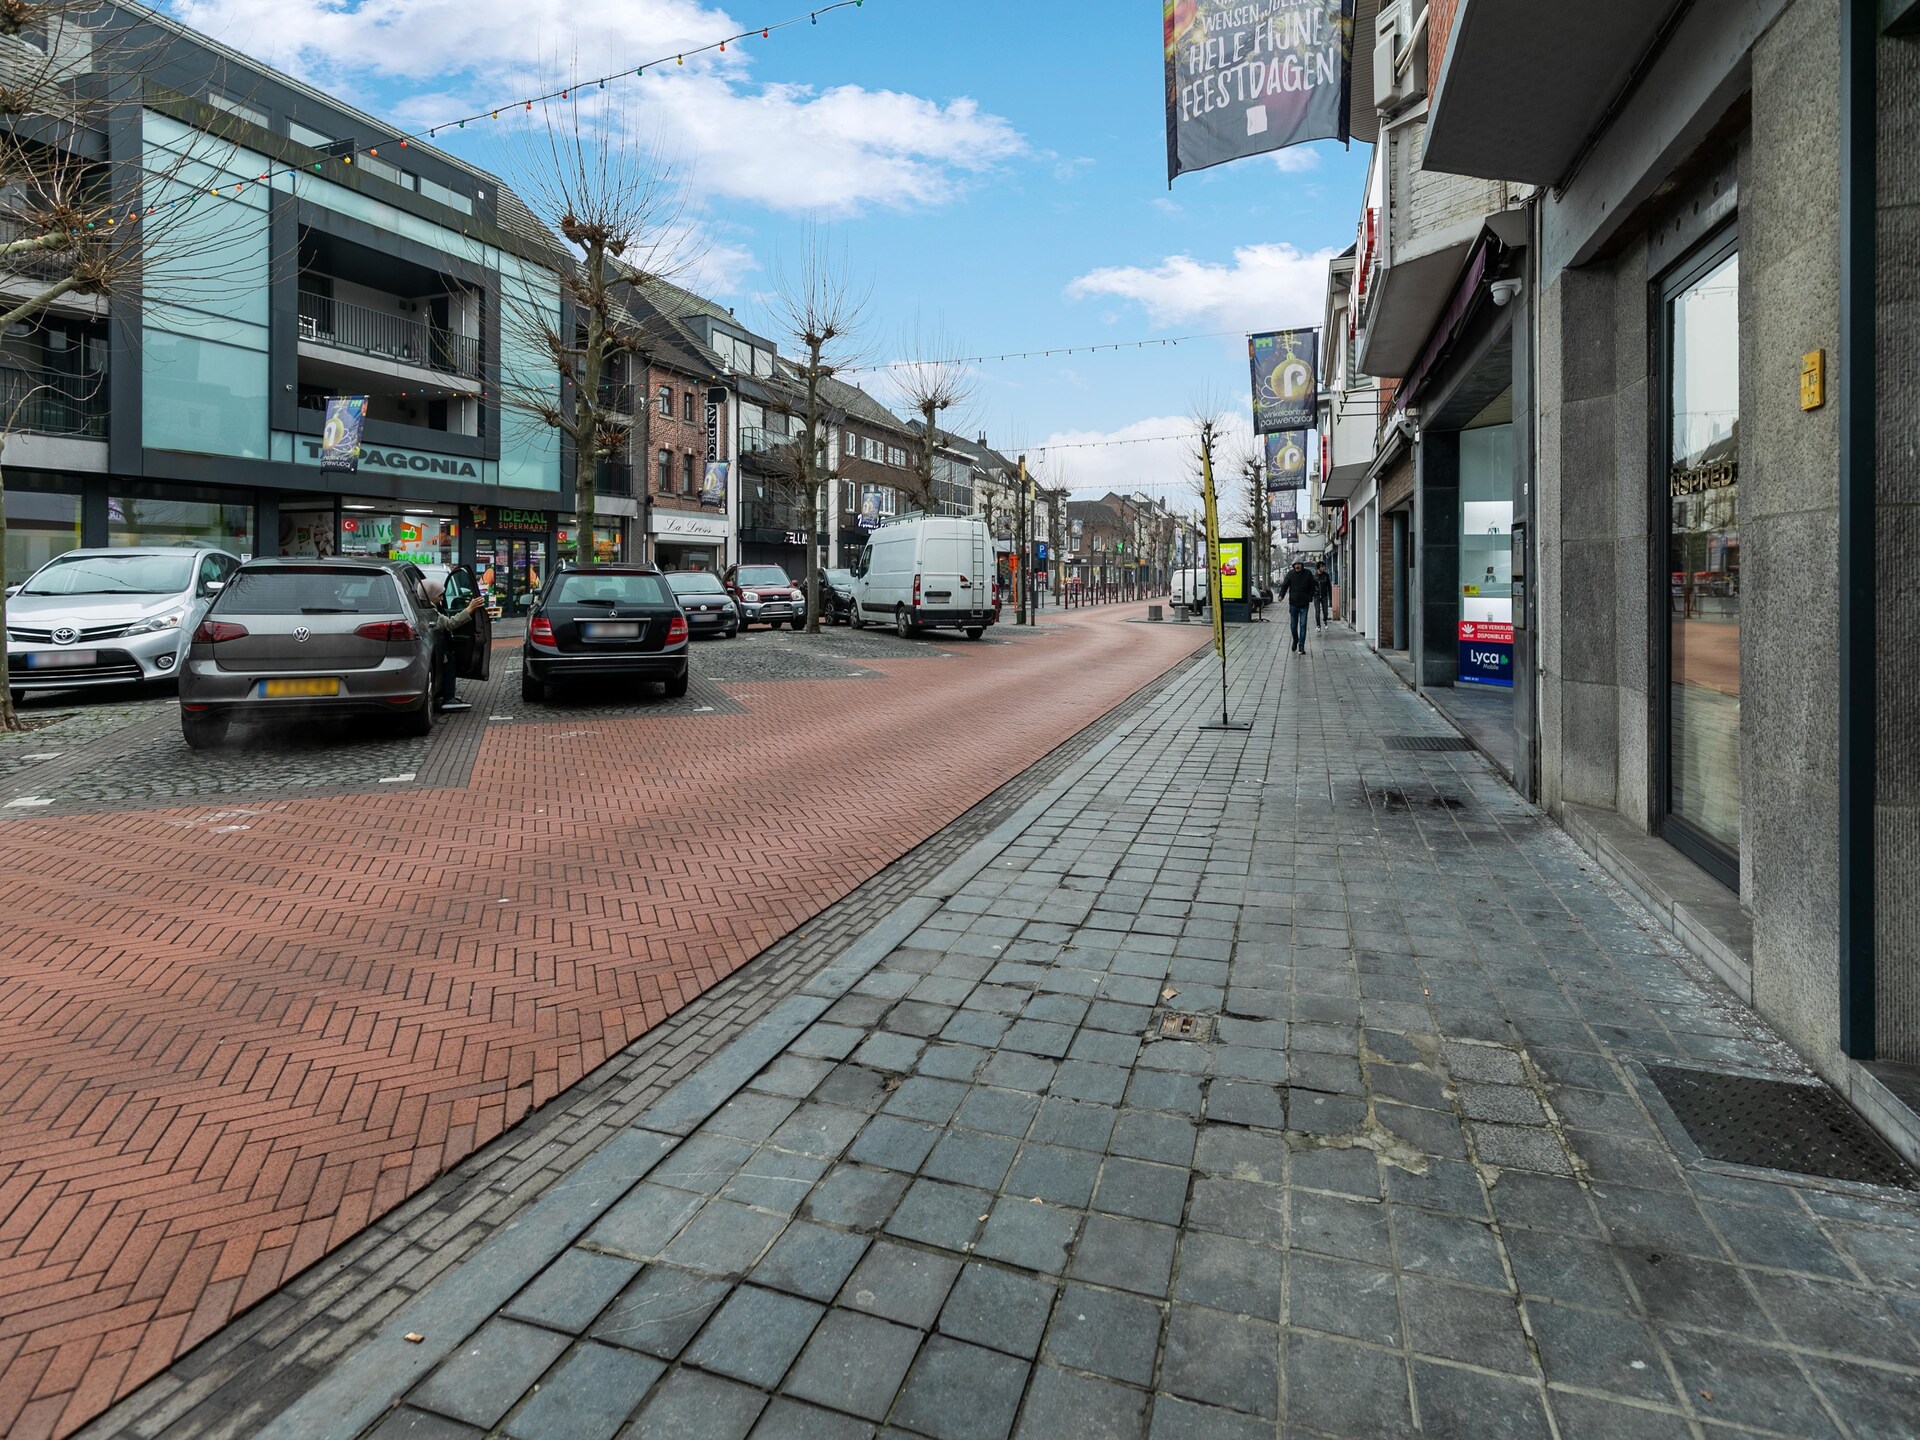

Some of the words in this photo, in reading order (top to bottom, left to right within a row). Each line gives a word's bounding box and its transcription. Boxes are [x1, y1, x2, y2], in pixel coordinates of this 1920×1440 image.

[1201, 4, 1259, 34] WENSEN
[1189, 31, 1246, 75] HELE
[1254, 7, 1323, 53] FIJNE
[1182, 47, 1334, 122] FEESTDAGEN
[1260, 414, 1313, 428] pauwengraaf
[1263, 408, 1310, 419] winkelcentrum
[302, 441, 477, 478] TAGONIA
[499, 509, 548, 524] IDEAAL
[498, 522, 548, 530] SUPERMARKT
[665, 518, 682, 531] La
[1470, 649, 1499, 665] Lyca
